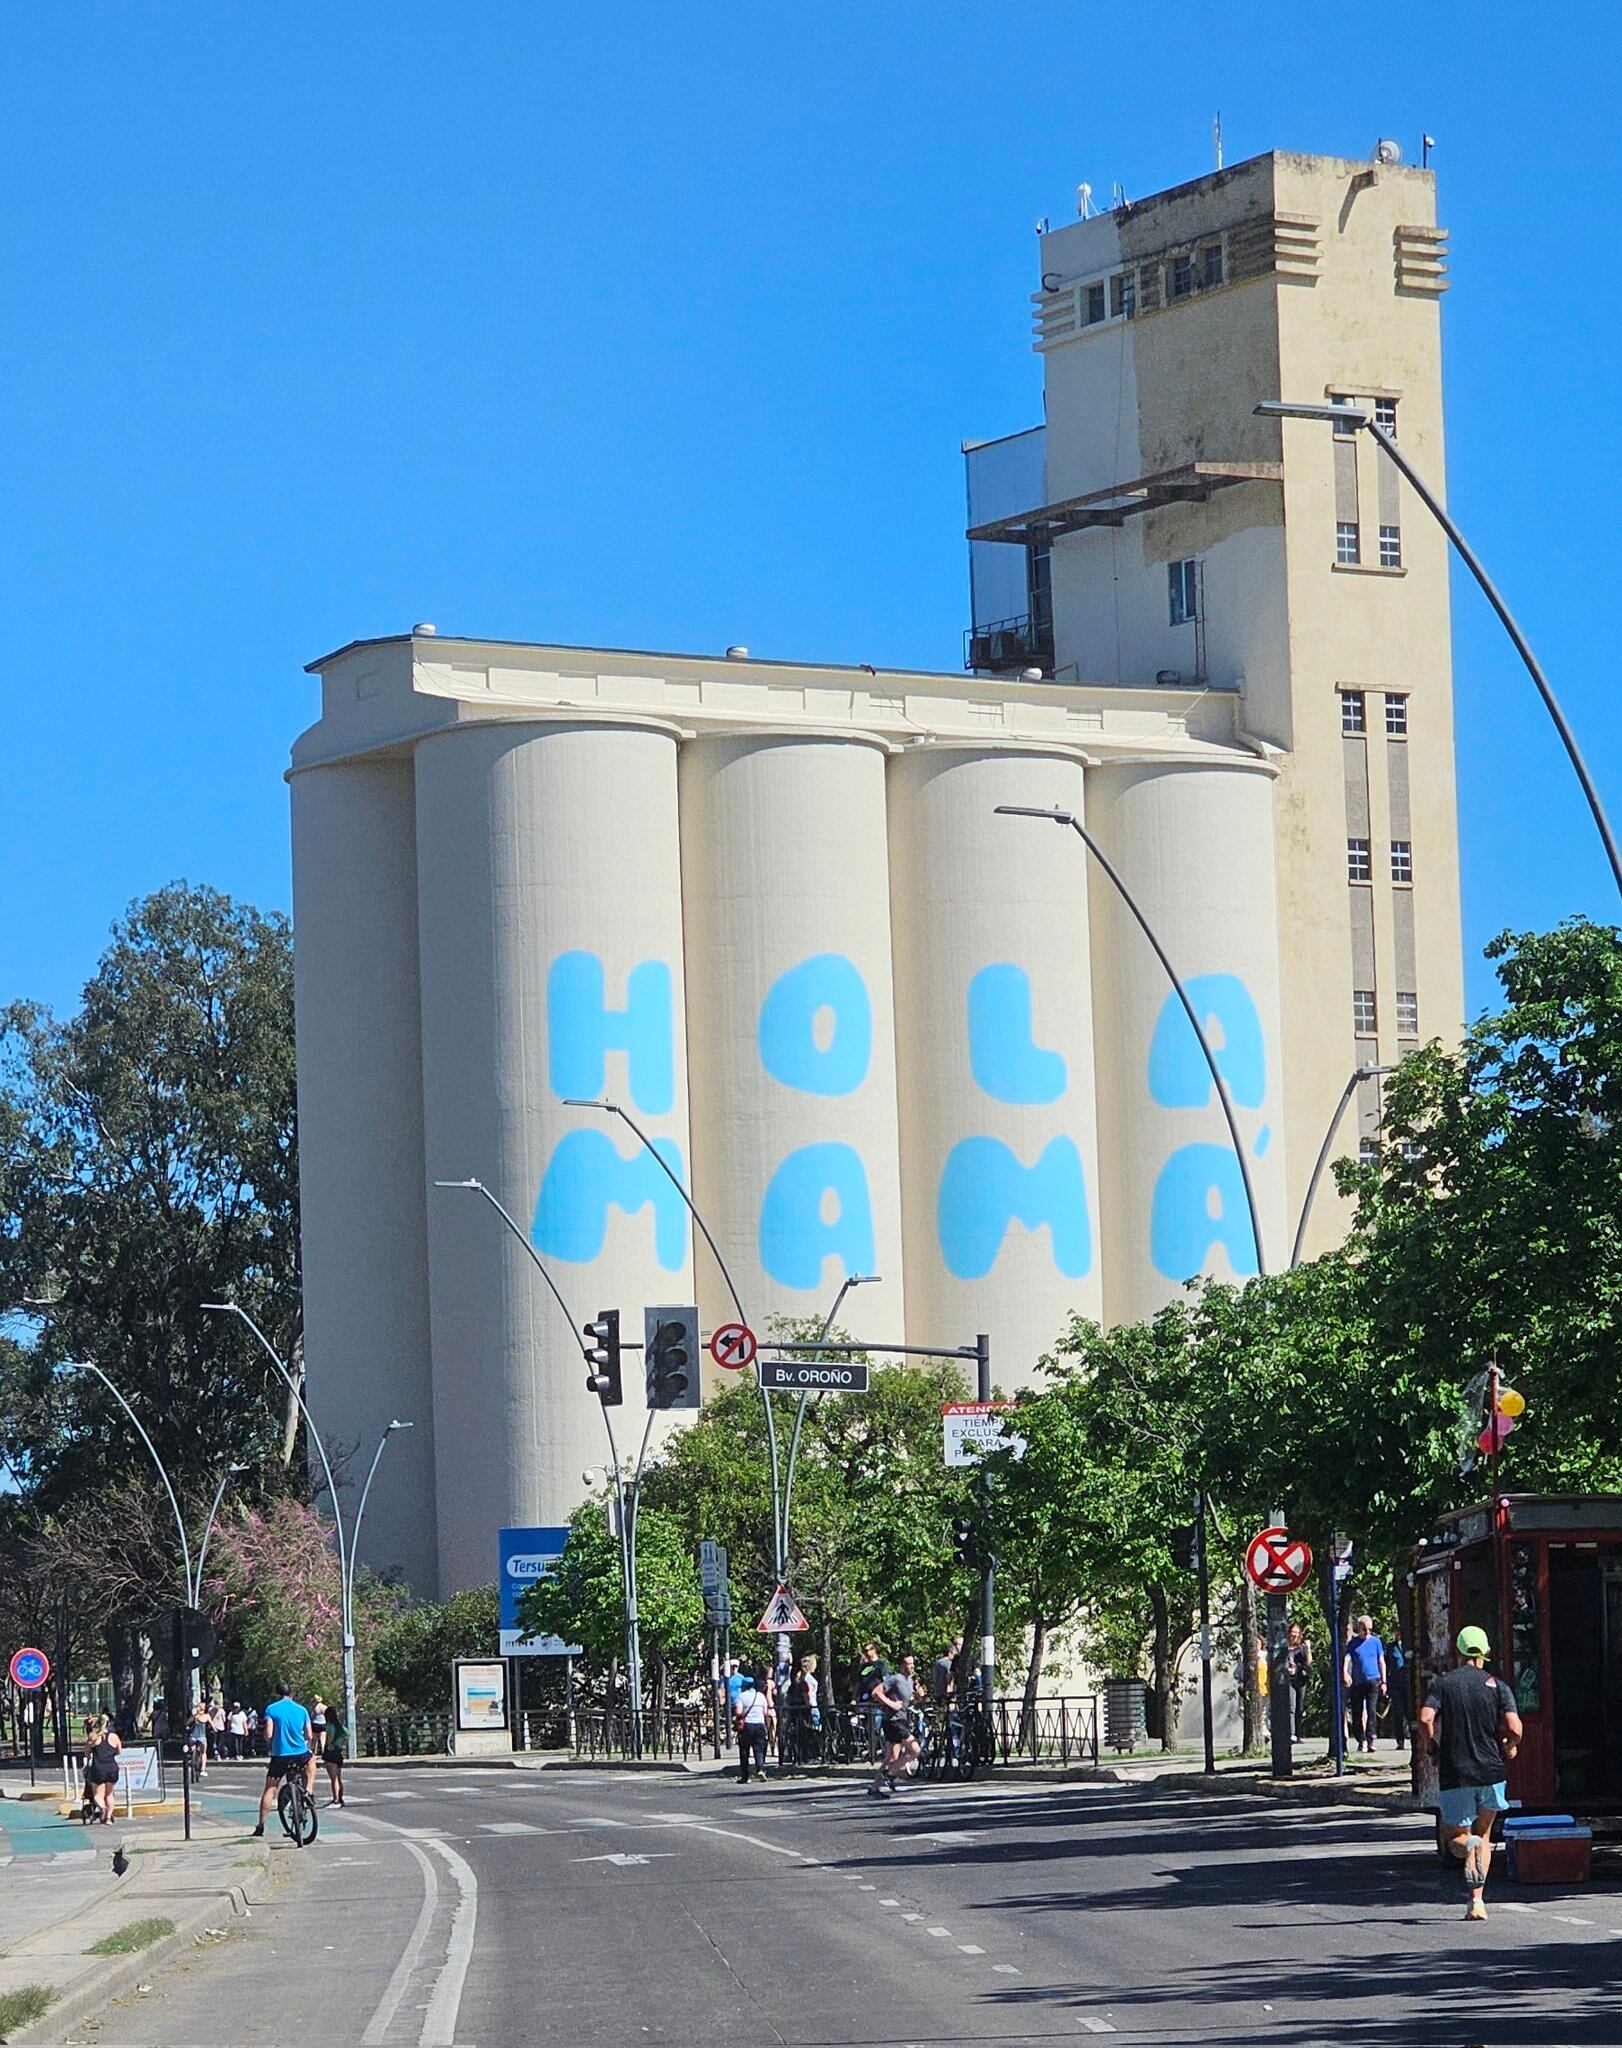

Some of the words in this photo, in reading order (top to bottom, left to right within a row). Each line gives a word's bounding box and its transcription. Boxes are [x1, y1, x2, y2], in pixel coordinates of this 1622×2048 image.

[547, 949, 1266, 1116] HOLA
[531, 1124, 1271, 1290] MAMÁ
[776, 1369, 795, 1381] Bv.
[798, 1369, 852, 1383] OROÑO
[952, 1429, 1018, 1438] EXCLUS
[970, 1439, 1003, 1447] ARA
[512, 1559, 546, 1573] Tersu
